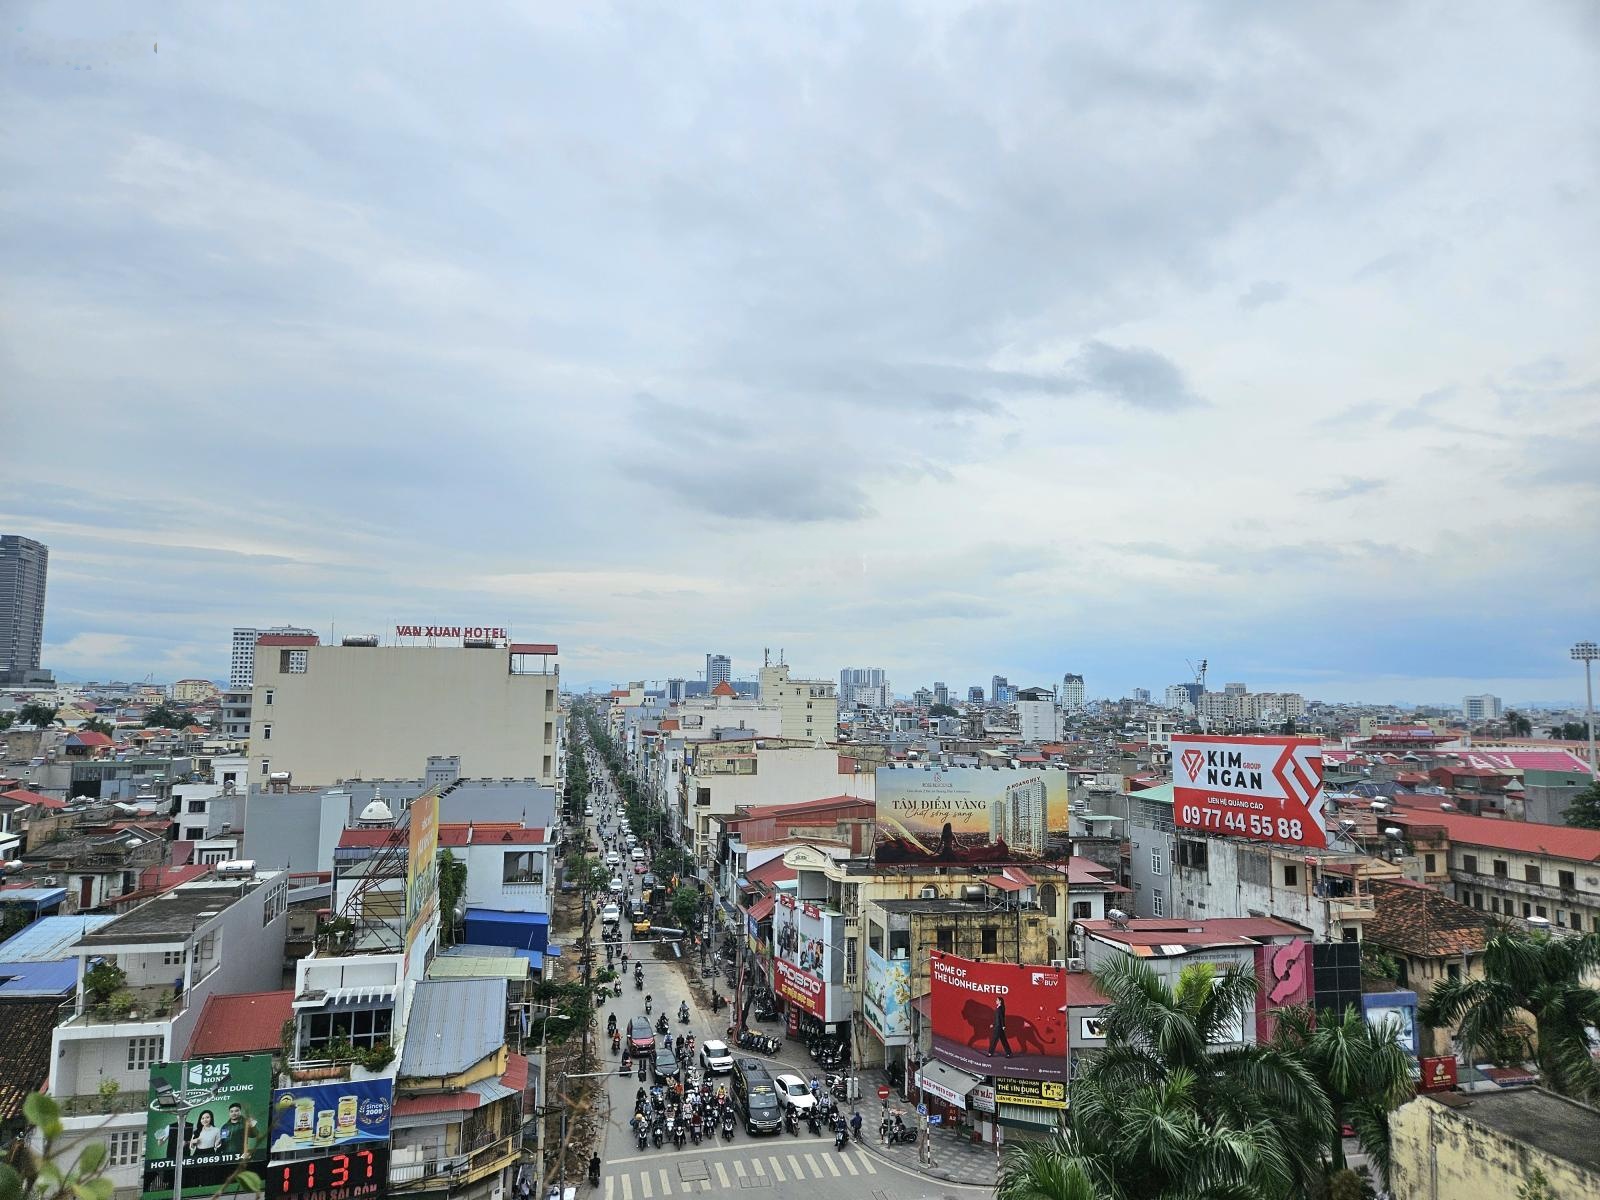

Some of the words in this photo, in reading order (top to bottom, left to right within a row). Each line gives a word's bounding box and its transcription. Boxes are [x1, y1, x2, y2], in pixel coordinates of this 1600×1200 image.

[396, 625, 422, 636] VAN
[425, 626, 460, 637] XUAN
[464, 627, 507, 638] HOTEL
[1207, 750, 1242, 769] KIM
[1242, 762, 1262, 771] GROUP
[1207, 768, 1263, 790] NGAN
[892, 797, 917, 810] TÂM
[954, 797, 987, 810] VÀNG
[1182, 805, 1200, 825] 09
[1202, 807, 1221, 828] 77
[1224, 811, 1246, 832] 44
[1250, 814, 1274, 837] 55
[1277, 817, 1303, 840] 88
[934, 961, 955, 975] HOME
[956, 968, 967, 977] OF
[934, 971, 948, 983] THE
[948, 975, 1009, 995] LIONHEARTED
[205, 1063, 230, 1076] 345
[230, 1084, 254, 1092] DÙNG
[150, 1158, 195, 1169] HOTLNE:
[197, 1155, 219, 1164] 0869
